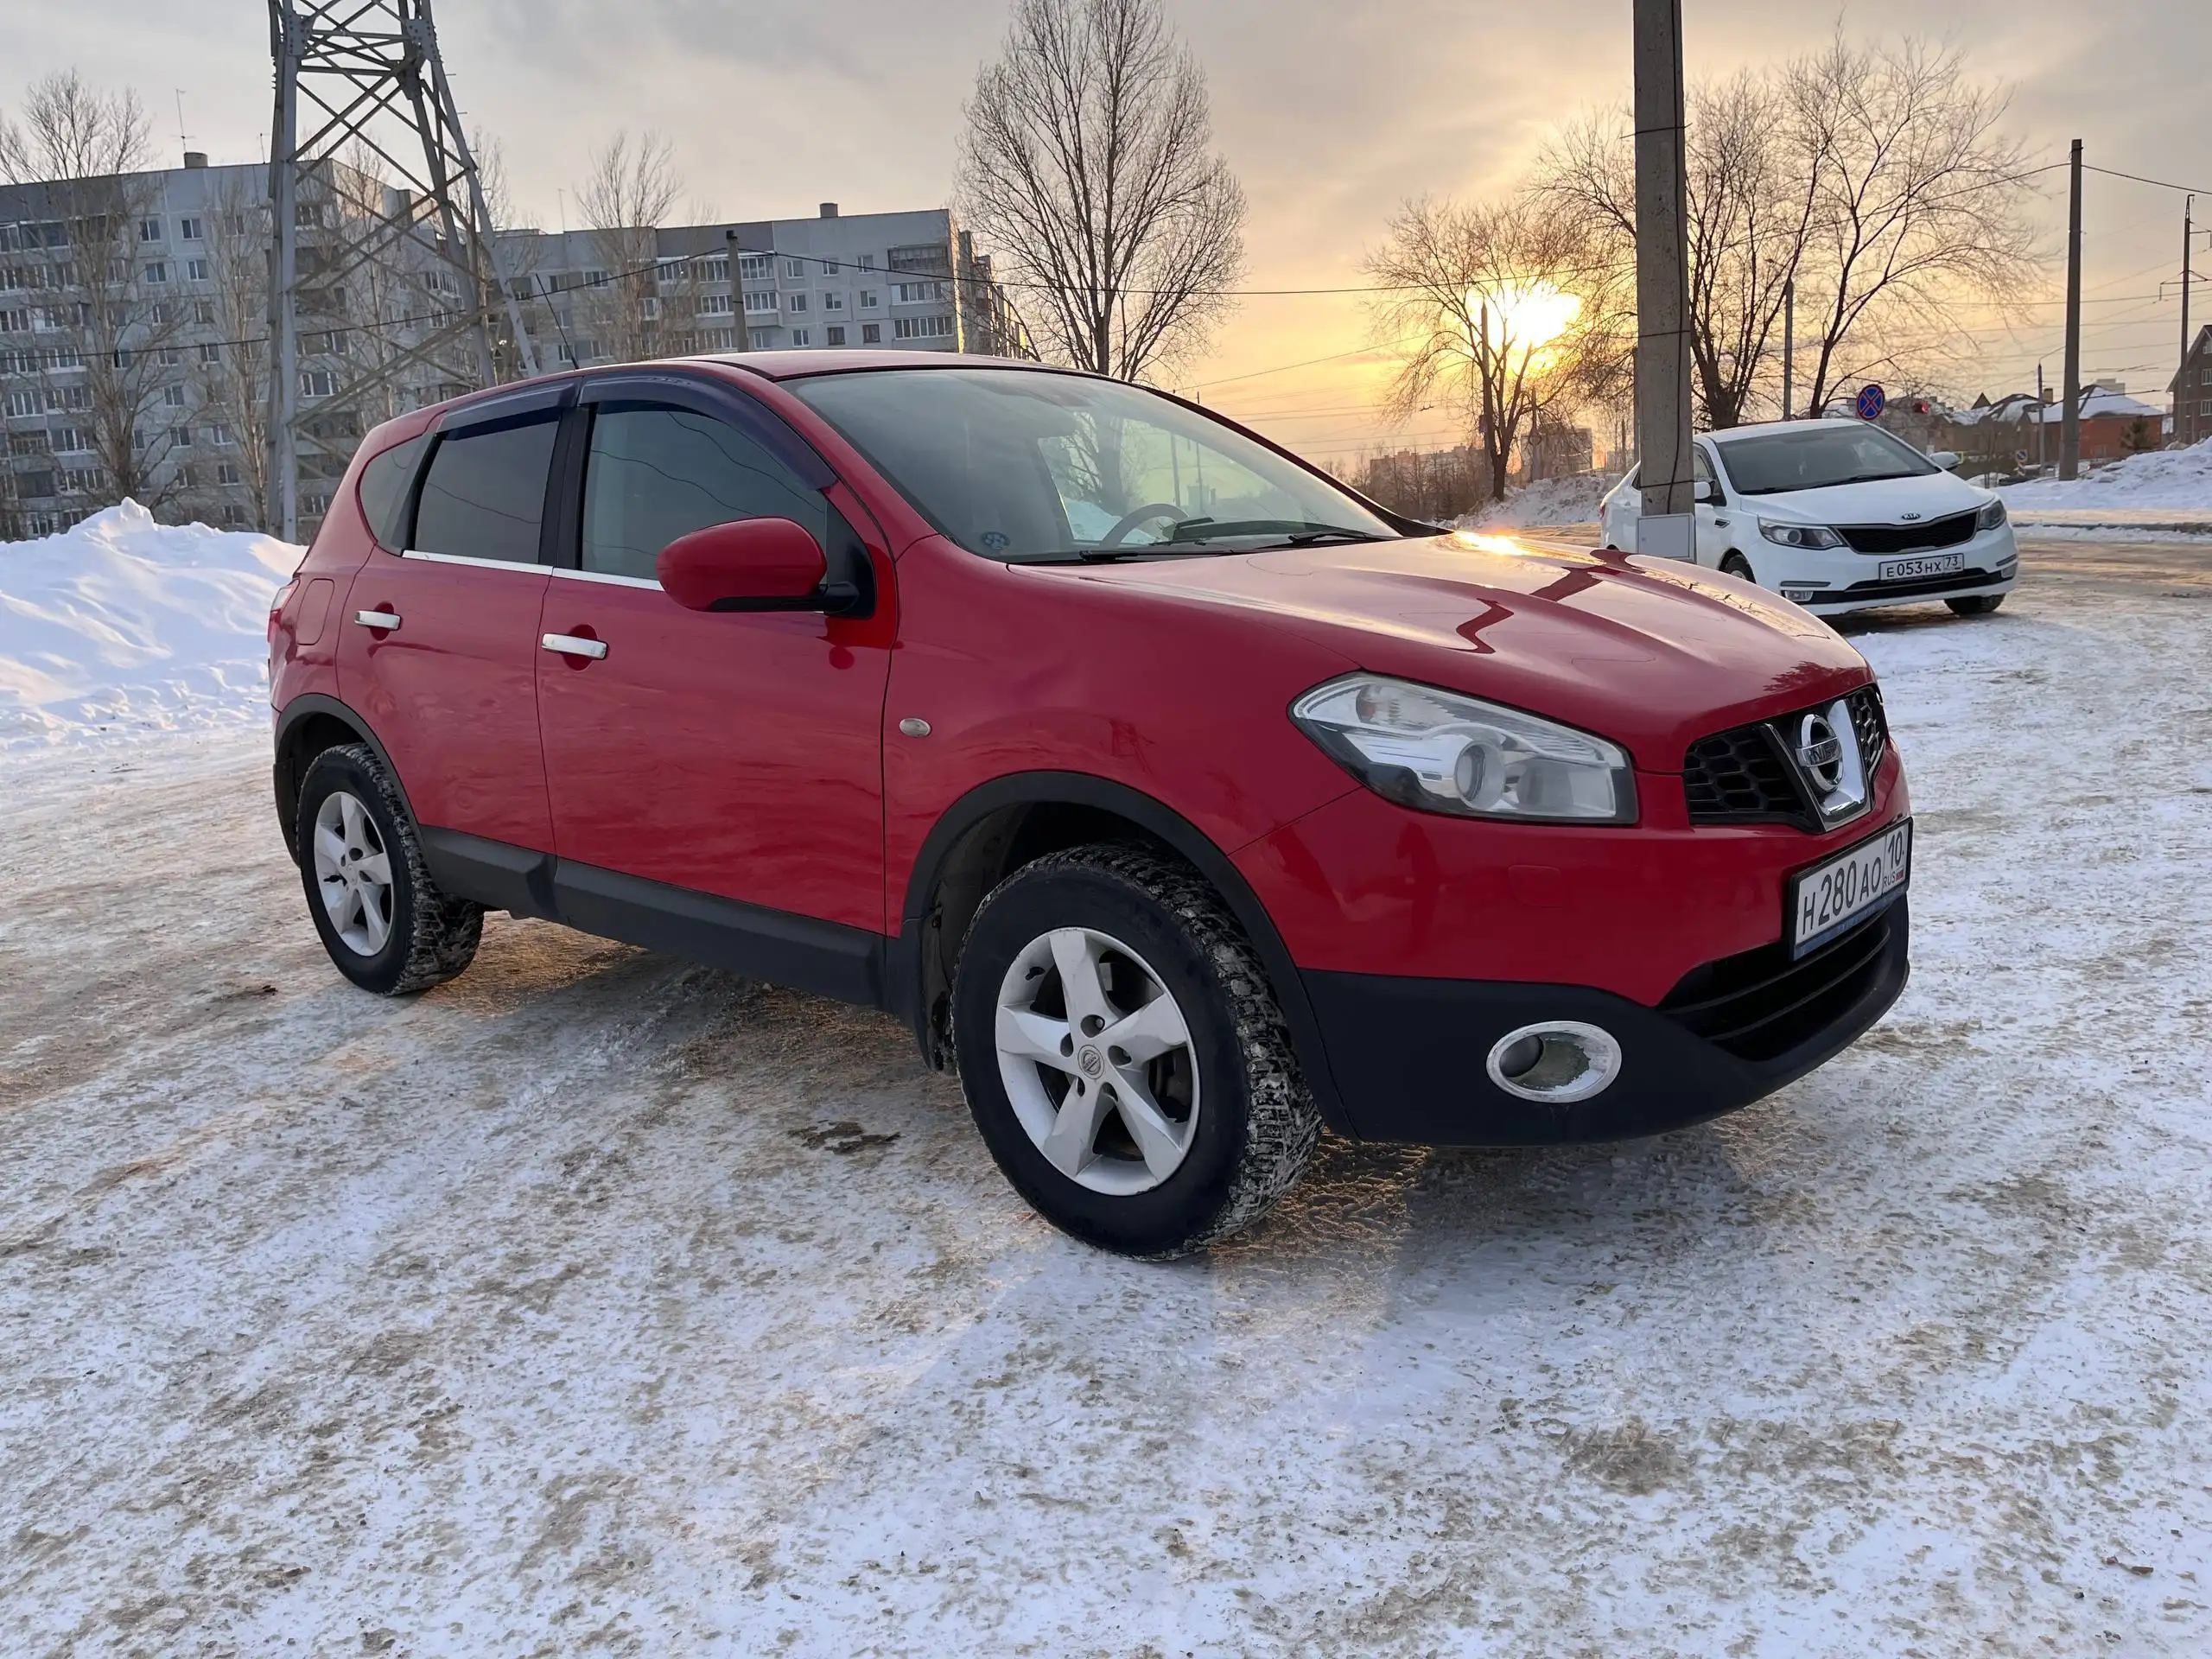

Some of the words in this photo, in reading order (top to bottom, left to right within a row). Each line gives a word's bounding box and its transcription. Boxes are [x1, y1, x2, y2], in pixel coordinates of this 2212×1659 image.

[1945, 556, 1958, 567] 73
[1888, 831, 1903, 869] 10
[1884, 871, 1896, 887] RUS
